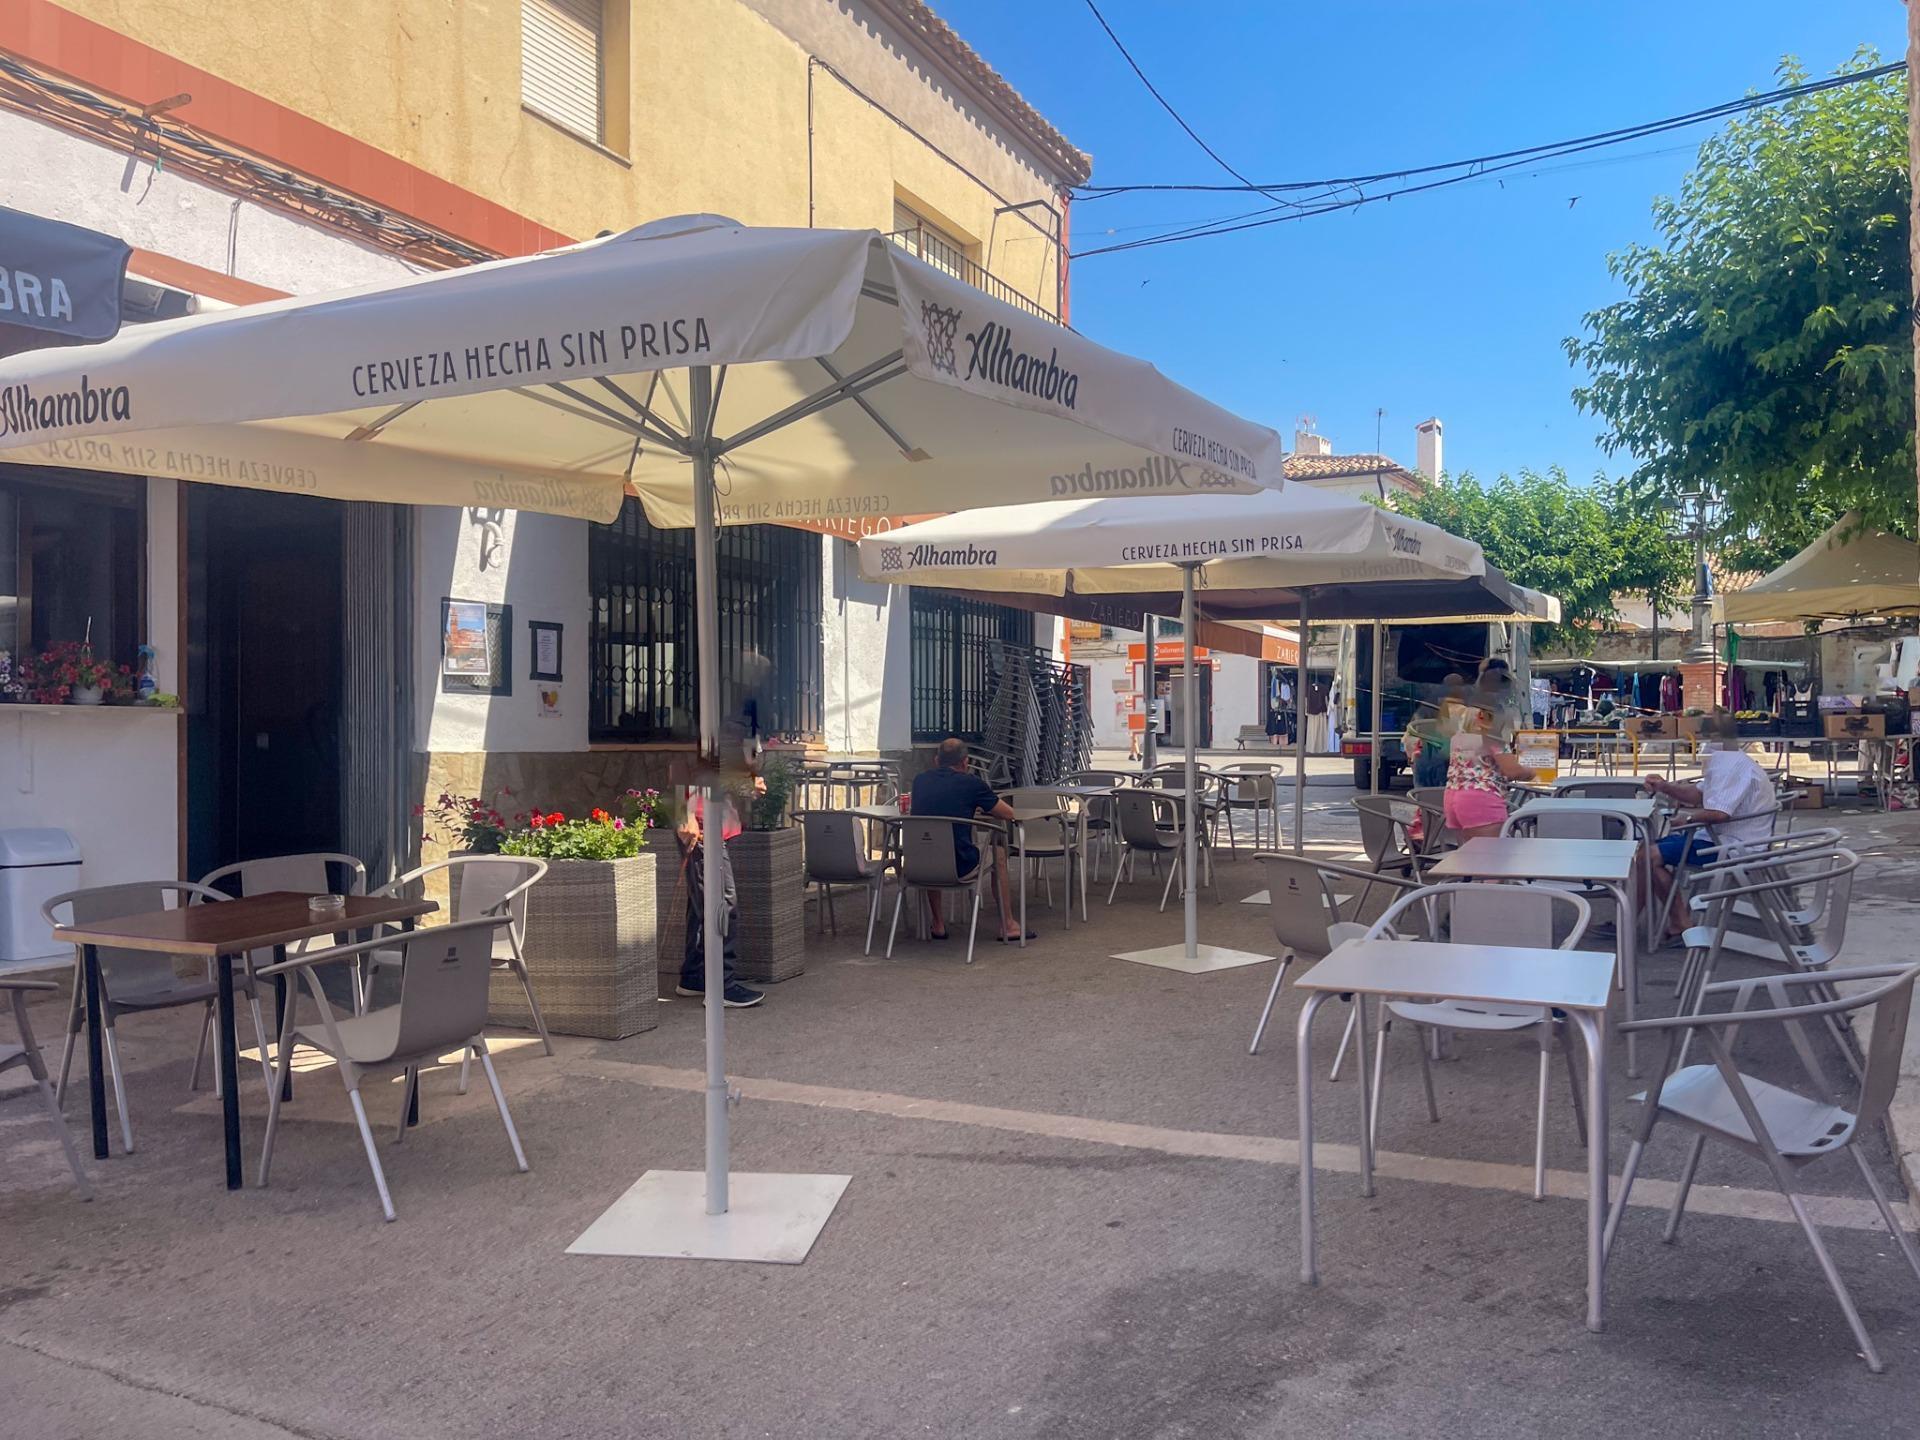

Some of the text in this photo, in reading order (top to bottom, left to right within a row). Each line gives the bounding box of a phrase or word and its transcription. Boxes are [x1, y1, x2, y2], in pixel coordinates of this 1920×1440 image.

[352, 317, 711, 396] CERVEZA HECHA SIN PRISA
[965, 321, 1079, 410] Alhambra
[0, 374, 131, 437] Alhambra
[1173, 427, 1206, 458] CERVEZA
[1207, 440, 1228, 467] HECHA
[907, 543, 997, 568] Alhambra
[1122, 535, 1303, 561] CERVEZA HECHA SIN PRISA
[1090, 600, 1140, 629] ZARIEGO
